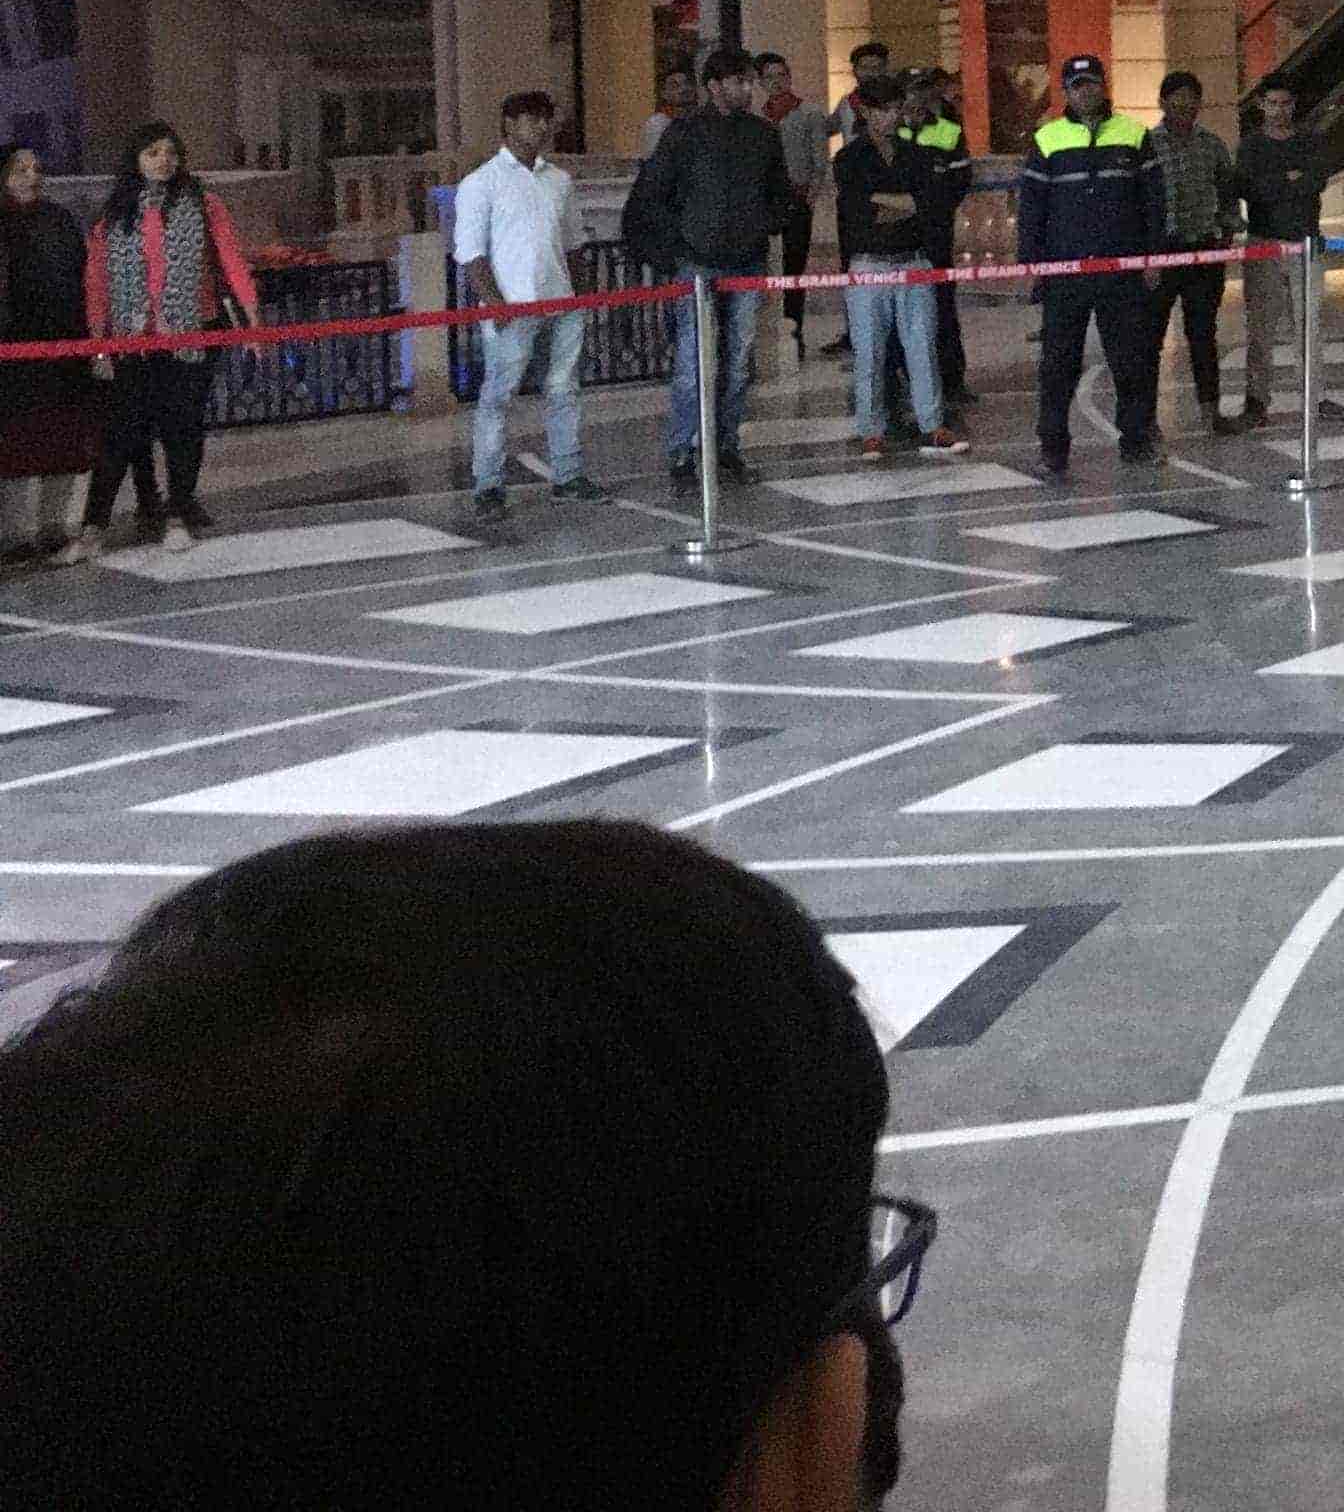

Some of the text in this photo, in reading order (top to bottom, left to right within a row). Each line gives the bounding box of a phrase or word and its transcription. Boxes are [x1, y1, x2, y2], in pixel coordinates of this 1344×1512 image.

[766, 268, 908, 289] THE GRAND VENICE
[945, 259, 1081, 281] THE GRAND VENICE
